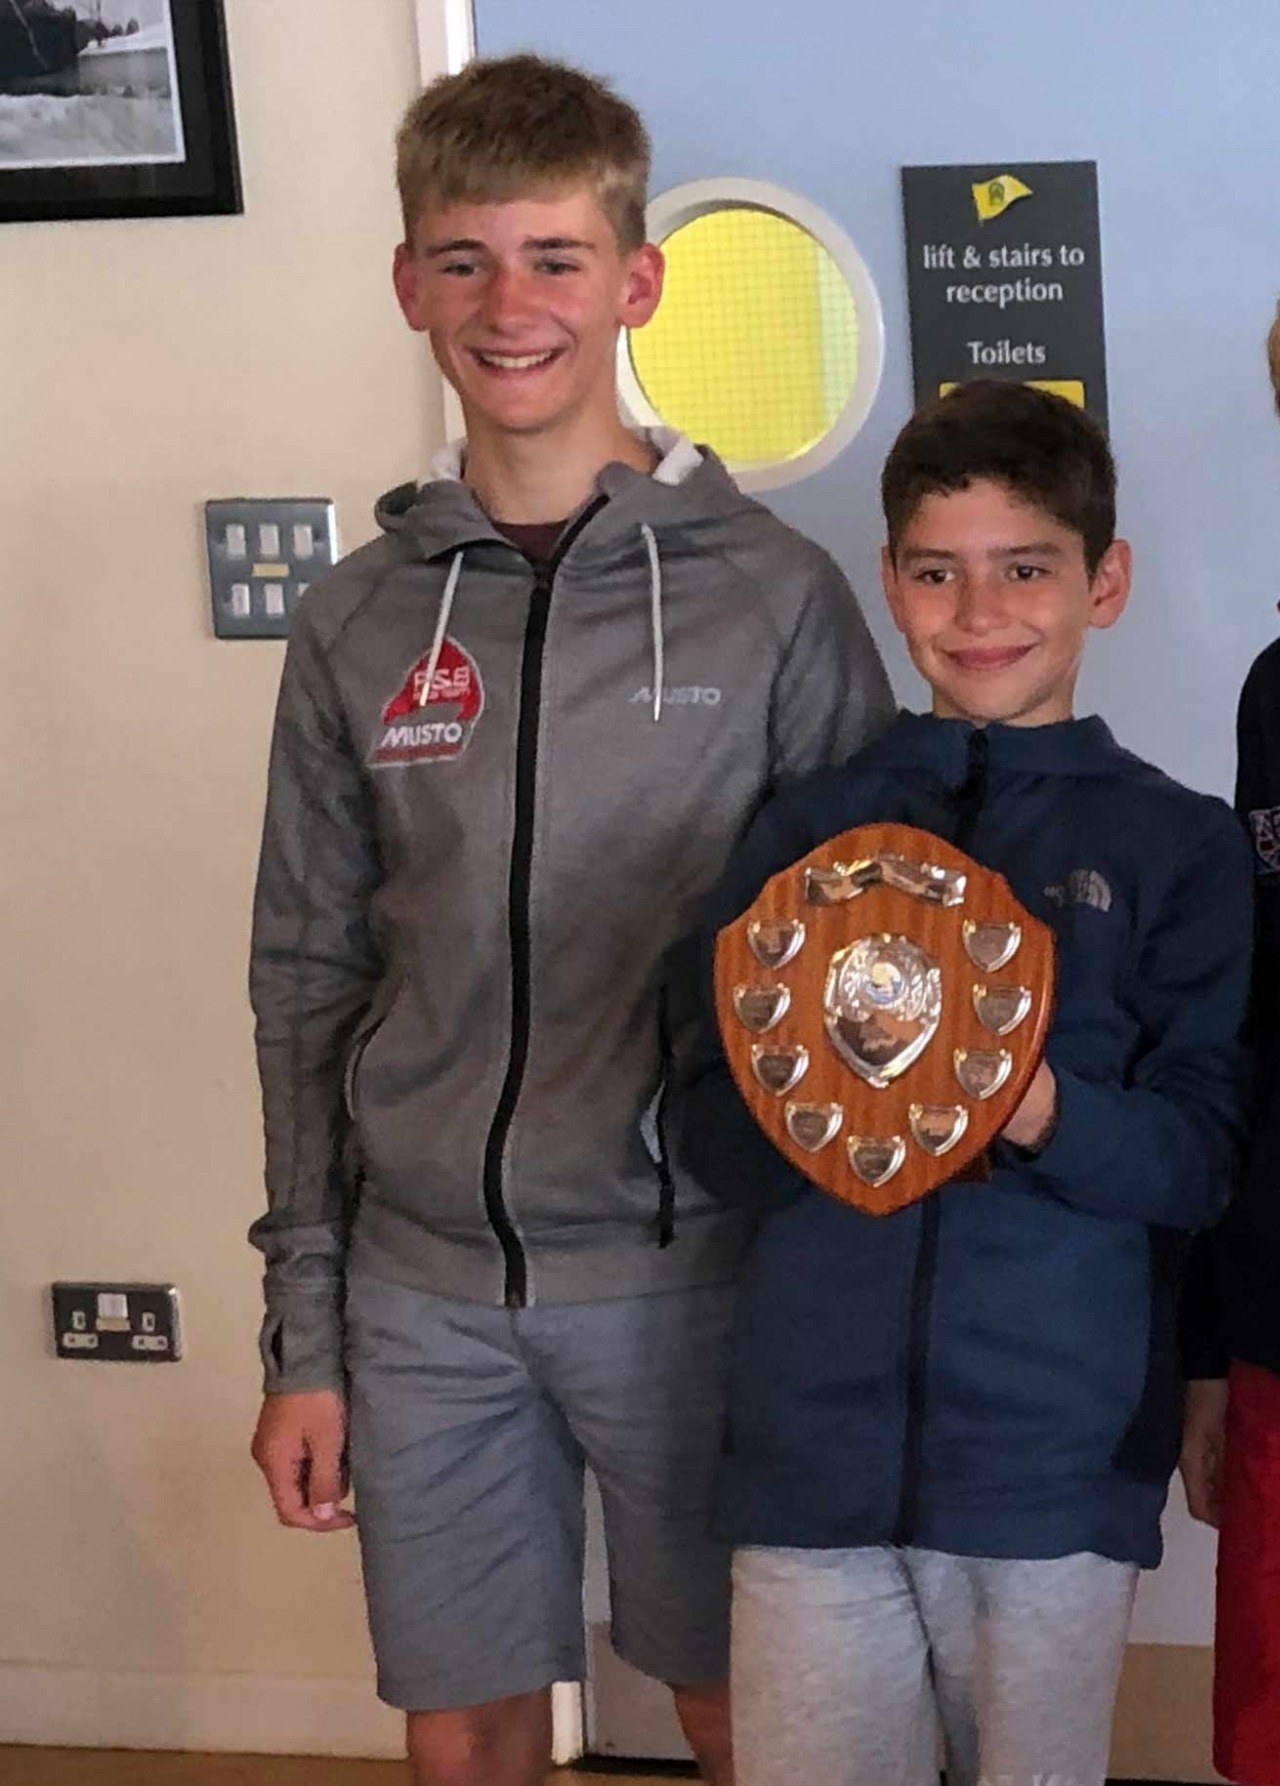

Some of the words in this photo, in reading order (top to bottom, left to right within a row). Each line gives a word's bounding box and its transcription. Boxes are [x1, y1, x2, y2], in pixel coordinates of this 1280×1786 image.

[922, 244, 956, 270] lift
[962, 246, 981, 269] &
[988, 243, 1053, 267] stairs
[1060, 244, 1085, 267] to
[945, 277, 1064, 309] reception
[966, 339, 1047, 365] Toilets
[380, 721, 463, 748] MUSTO
